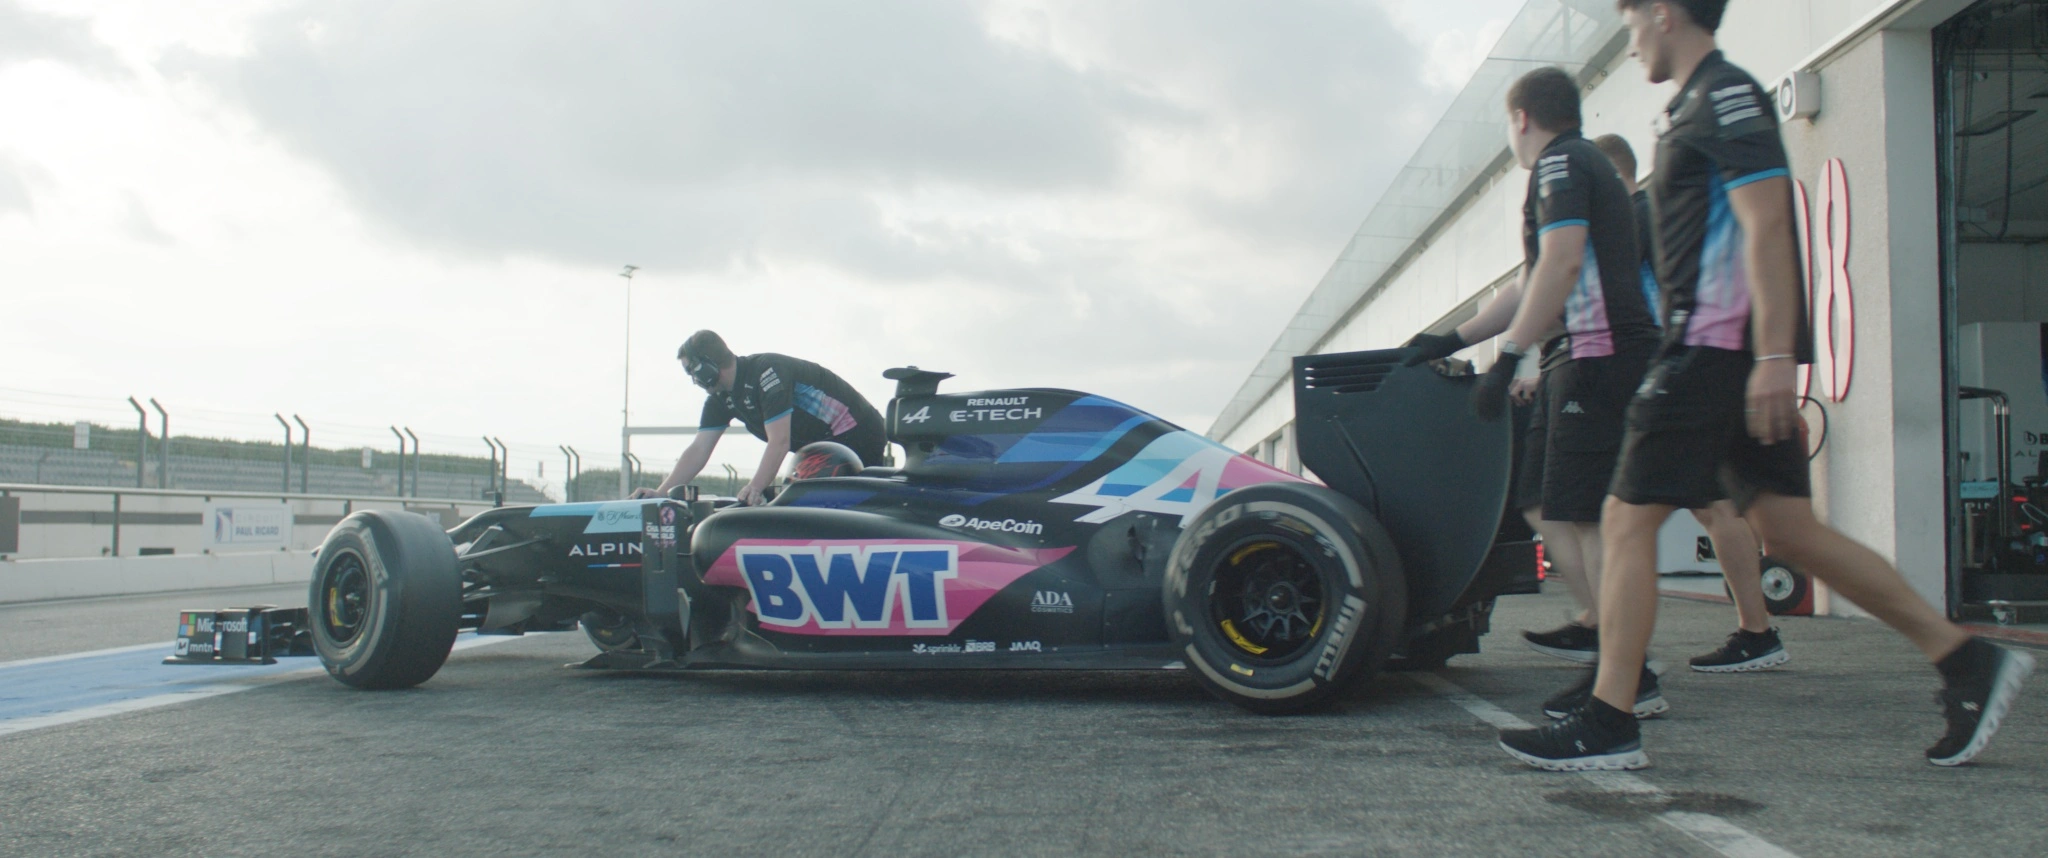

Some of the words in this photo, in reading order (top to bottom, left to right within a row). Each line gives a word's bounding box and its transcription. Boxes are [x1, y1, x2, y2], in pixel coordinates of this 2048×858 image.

[967, 396, 1029, 407] RENAULT
[949, 407, 1042, 422] E-TECH
[235, 526, 253, 535] PAUL
[255, 526, 279, 535] RICARD
[645, 525, 675, 533] CHANGE
[965, 517, 1043, 535] ApeCoin
[568, 542, 643, 556] ALPIN
[735, 545, 958, 629] BWT
[1031, 590, 1073, 605] ADA
[196, 617, 248, 633] Microsoft
[189, 643, 213, 653] mntn
